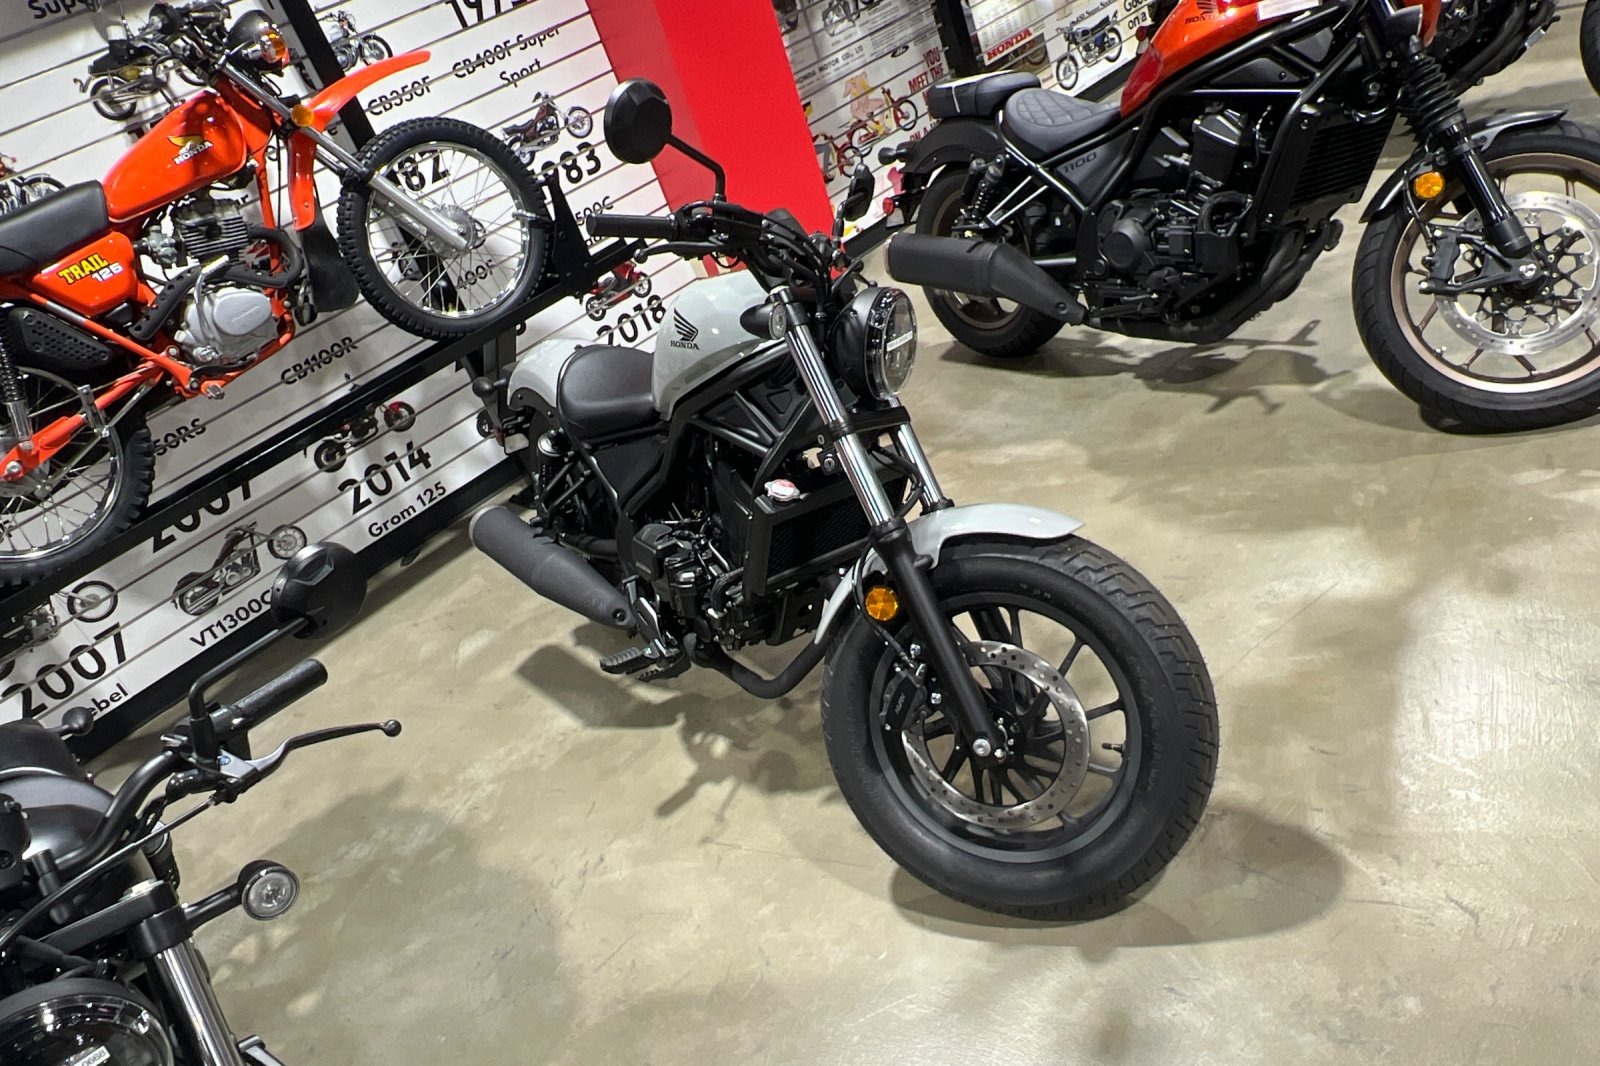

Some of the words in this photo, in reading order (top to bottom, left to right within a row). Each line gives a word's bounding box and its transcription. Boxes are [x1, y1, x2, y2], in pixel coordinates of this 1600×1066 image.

[1128, 16, 1141, 30] on
[1140, 11, 1148, 22] a
[922, 46, 941, 68] YOU
[986, 27, 1033, 61] HONDA
[367, 76, 433, 117] CB350F
[452, 39, 511, 79] CB400F
[516, 26, 560, 51] Super
[499, 58, 541, 88] Sport
[908, 71, 929, 95] MEET
[929, 62, 945, 81] THE
[173, 140, 213, 165] HONDA
[1062, 152, 1097, 173] 1100
[57, 252, 110, 285] TRAIL
[91, 262, 123, 282] 125
[281, 336, 358, 385] CB1100R
[670, 339, 700, 351] HONDA
[338, 440, 432, 516] 2014
[368, 505, 417, 538] Grom
[416, 481, 447, 507] 125
[1, 621, 126, 720] 2007
